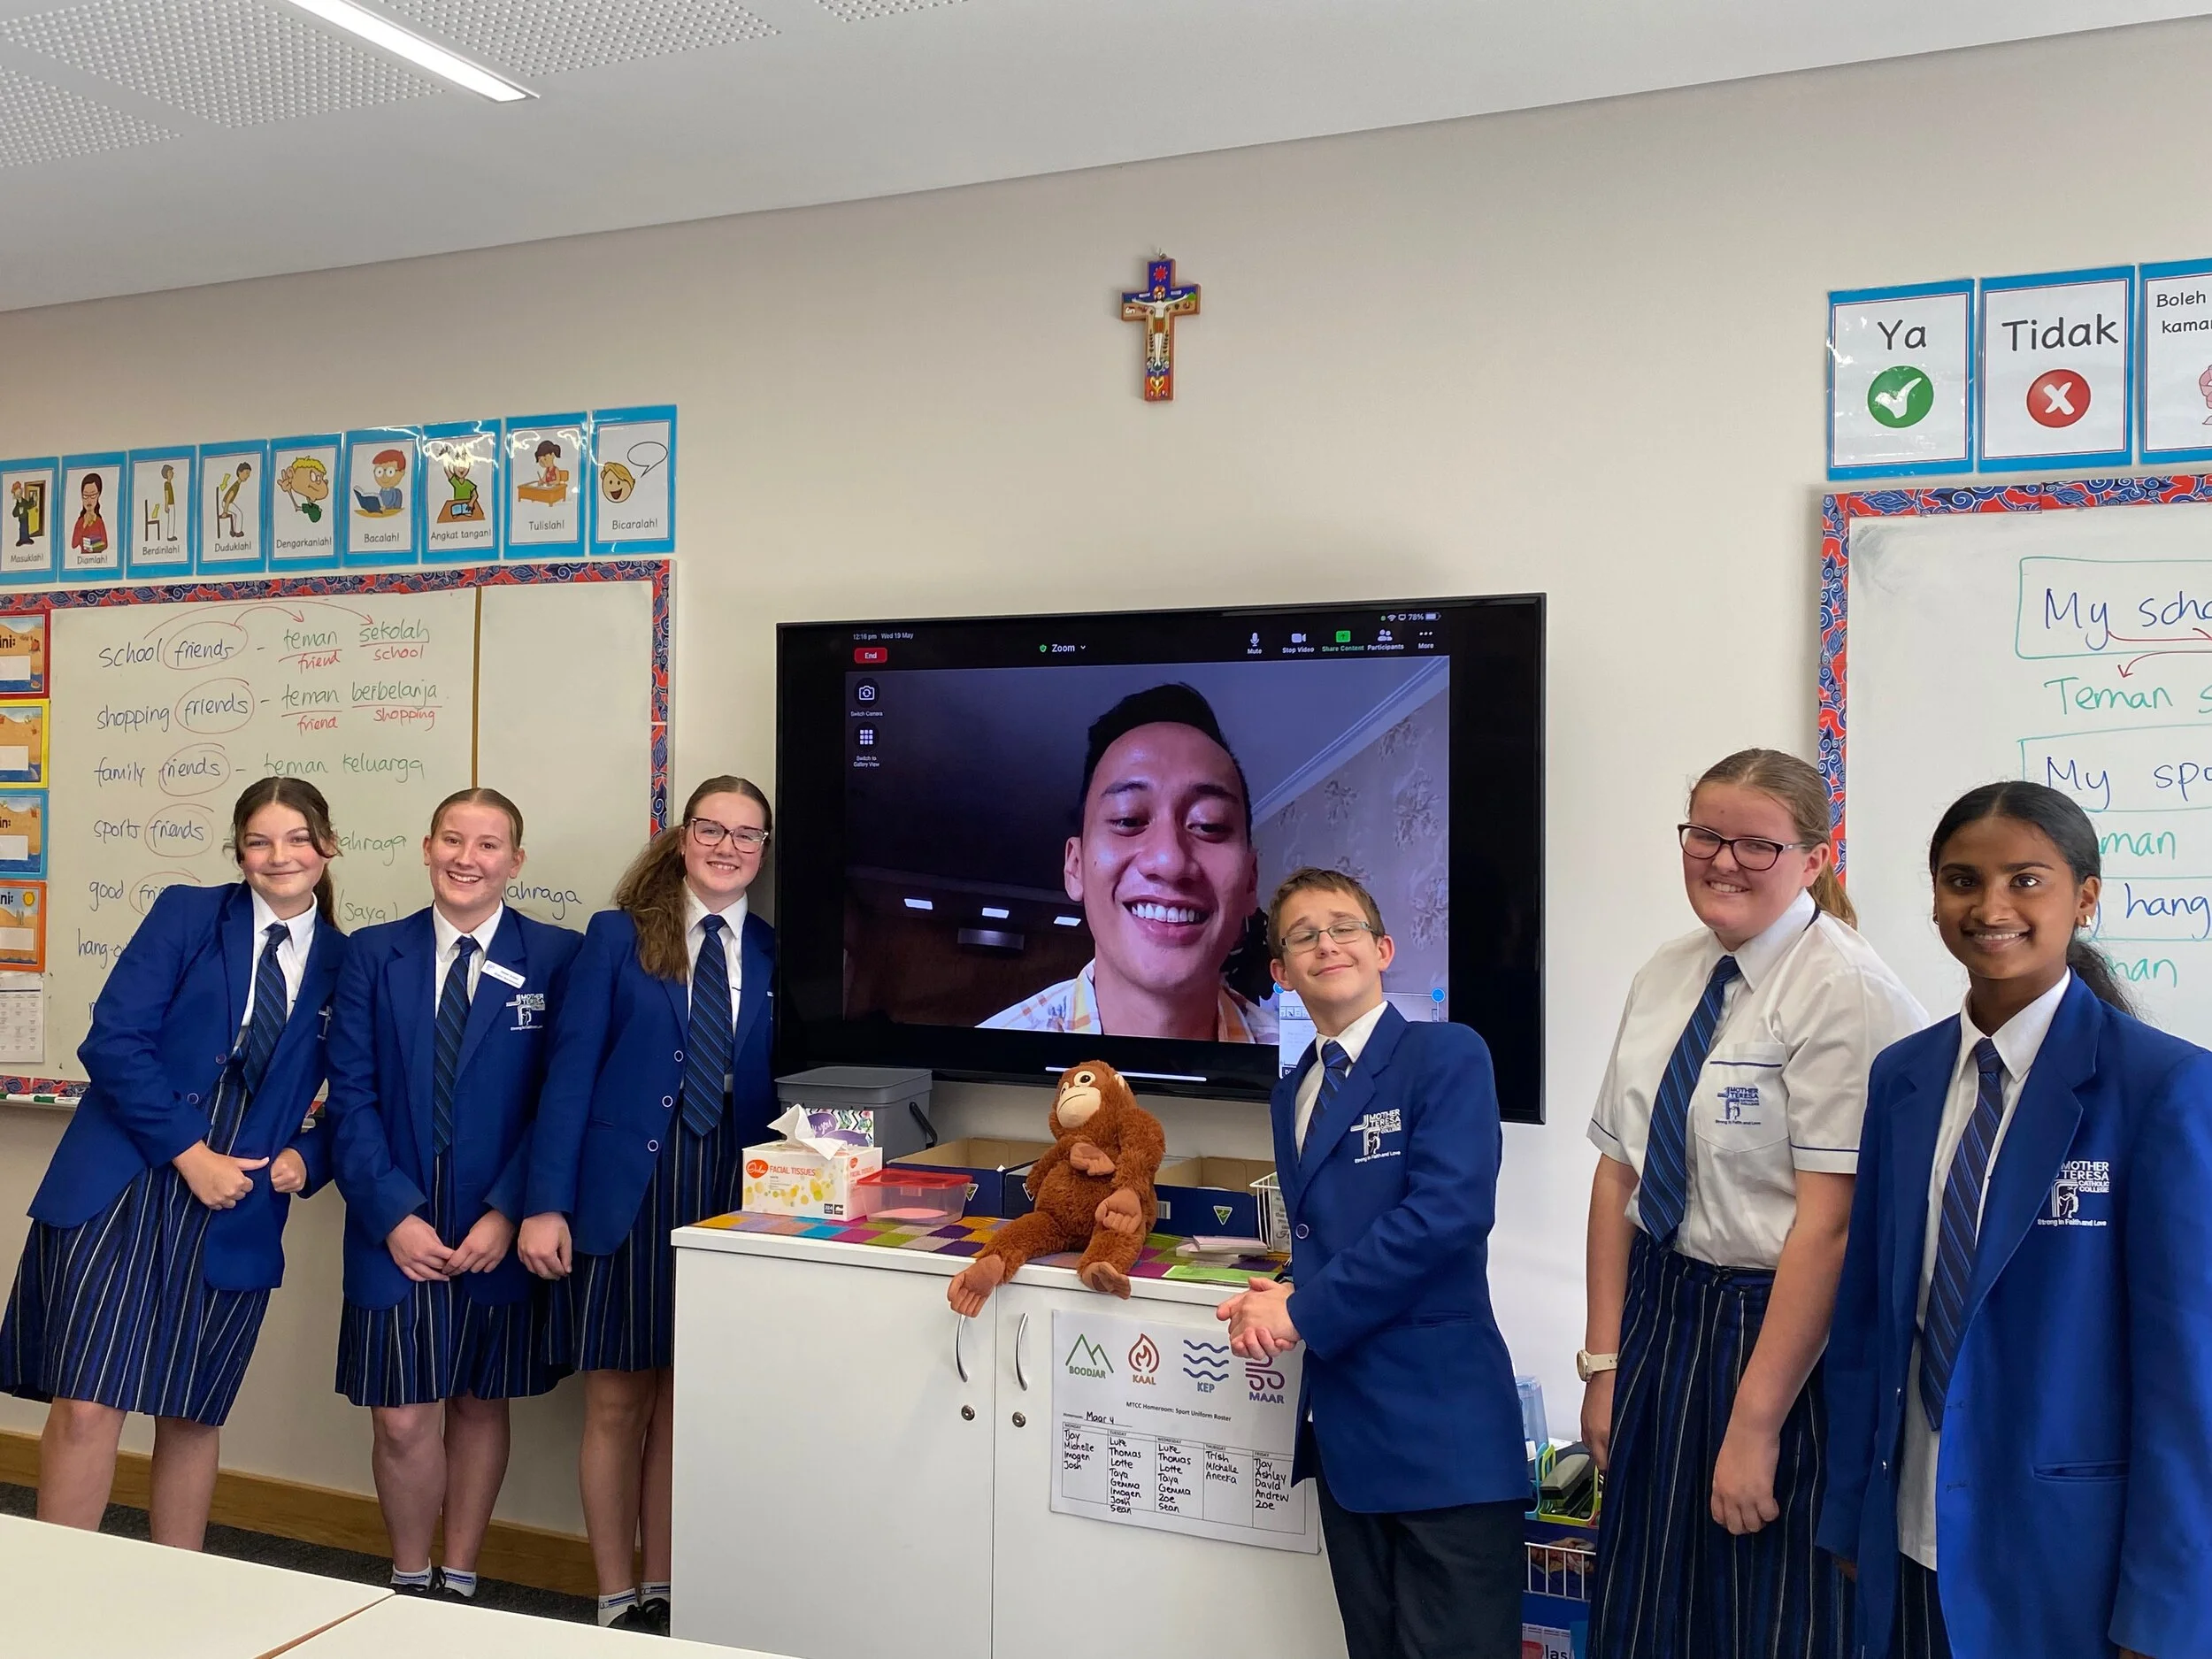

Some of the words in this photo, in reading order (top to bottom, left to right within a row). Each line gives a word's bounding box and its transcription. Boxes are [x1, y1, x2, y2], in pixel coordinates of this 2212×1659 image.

[2156, 290, 2206, 307] Boleh
[1878, 319, 1926, 350] Ya
[2001, 314, 2119, 351] Tidak
[529, 520, 565, 531] Tulislah!
[612, 518, 658, 530] Bicaralah!
[364, 534, 400, 543] Bacalah!
[431, 531, 458, 542] Angkat
[460, 528, 491, 540] tangan!
[214, 542, 251, 552] Duduklah!
[277, 538, 332, 549] Dengarkanlah!
[142, 545, 180, 555] Berdirilah!
[11, 554, 44, 563] Masuklah!
[77, 556, 108, 565] Diamlah!
[2046, 588, 2108, 650] My
[99, 639, 161, 668] school
[174, 639, 234, 666] friends
[283, 628, 338, 649] teman
[359, 619, 430, 643] sekolah
[1052, 643, 1075, 653] Zoom
[298, 652, 340, 673] friend
[373, 645, 423, 662] school
[2044, 677, 2173, 715] Teman
[96, 706, 170, 733] shopping
[185, 694, 248, 726] friends
[281, 684, 339, 705] teman
[351, 681, 437, 707] berbelanja
[297, 716, 339, 736] friend
[373, 708, 435, 731] shopping
[95, 757, 145, 787] family
[160, 752, 220, 784] friends
[264, 753, 328, 776] teman
[343, 753, 425, 784] keluarga
[2047, 757, 2110, 810] My
[94, 818, 141, 844] sports
[150, 818, 204, 848] friends
[2101, 832, 2176, 860] man
[89, 880, 124, 911] good
[2124, 883, 2210, 941] hang
[1370, 1109, 1400, 1120] MOTHER
[1370, 1116, 1401, 1127] TERESA
[791, 1167, 816, 1176] TISSUES
[2061, 1161, 2109, 1171] MOTHER
[2062, 1171, 2109, 1181] TERESA
[1070, 1366, 1106, 1379] BOODJAR
[1133, 1375, 1156, 1386] KAAL
[1197, 1382, 1215, 1394] KEP
[1249, 1392, 1285, 1404] MAAR
[1143, 1404, 1174, 1413] Homeroom:
[1087, 1411, 1107, 1422] Maar
[1064, 1441, 1094, 1452] Michelle
[1110, 1437, 1126, 1447] Luke
[1110, 1448, 1141, 1458] Thomas
[1159, 1444, 1181, 1454] Luke
[1064, 1451, 1090, 1462] Imogen
[1158, 1453, 1191, 1465] Thomas
[1206, 1451, 1229, 1463] Trish
[1064, 1460, 1082, 1470] Josh
[1111, 1458, 1133, 1469] Lotte
[1160, 1464, 1183, 1474] Lotte
[1206, 1463, 1239, 1474] Michelle
[1110, 1468, 1128, 1480] Taya
[1158, 1473, 1179, 1486] Taya
[1256, 1469, 1286, 1483] Ashley
[1110, 1479, 1140, 1489] Gemma
[1159, 1484, 1191, 1495] Gemma
[1256, 1479, 1281, 1490] David
[1110, 1488, 1141, 1500] Imogen
[1256, 1489, 1289, 1502] Andrew
[1110, 1496, 1130, 1506] Josh
[1110, 1505, 1132, 1515] Sean
[1159, 1503, 1179, 1513] Sean
